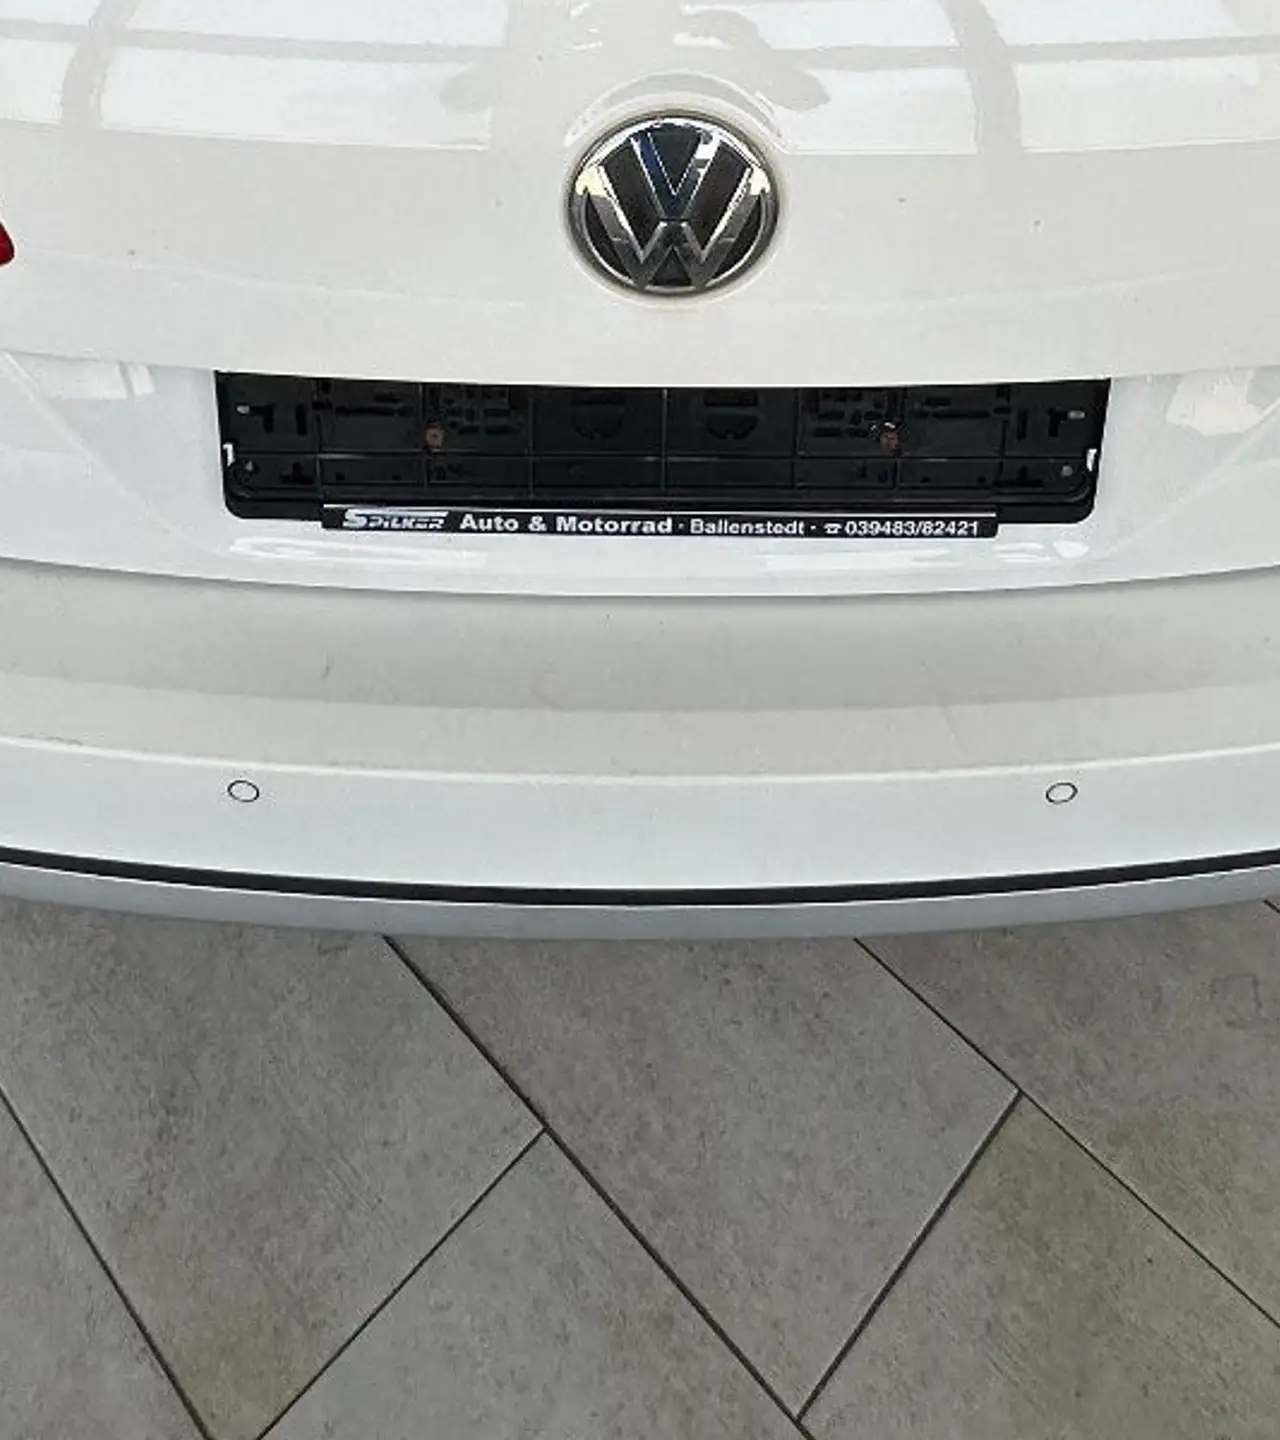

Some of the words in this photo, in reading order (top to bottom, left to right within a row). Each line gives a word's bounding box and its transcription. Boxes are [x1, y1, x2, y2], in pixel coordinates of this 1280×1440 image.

[460, 513, 519, 532] Auto
[528, 515, 547, 532] &
[556, 516, 673, 534] Motorrad
[690, 518, 804, 536] Ballenstedt
[844, 520, 978, 536] 039483/82421
